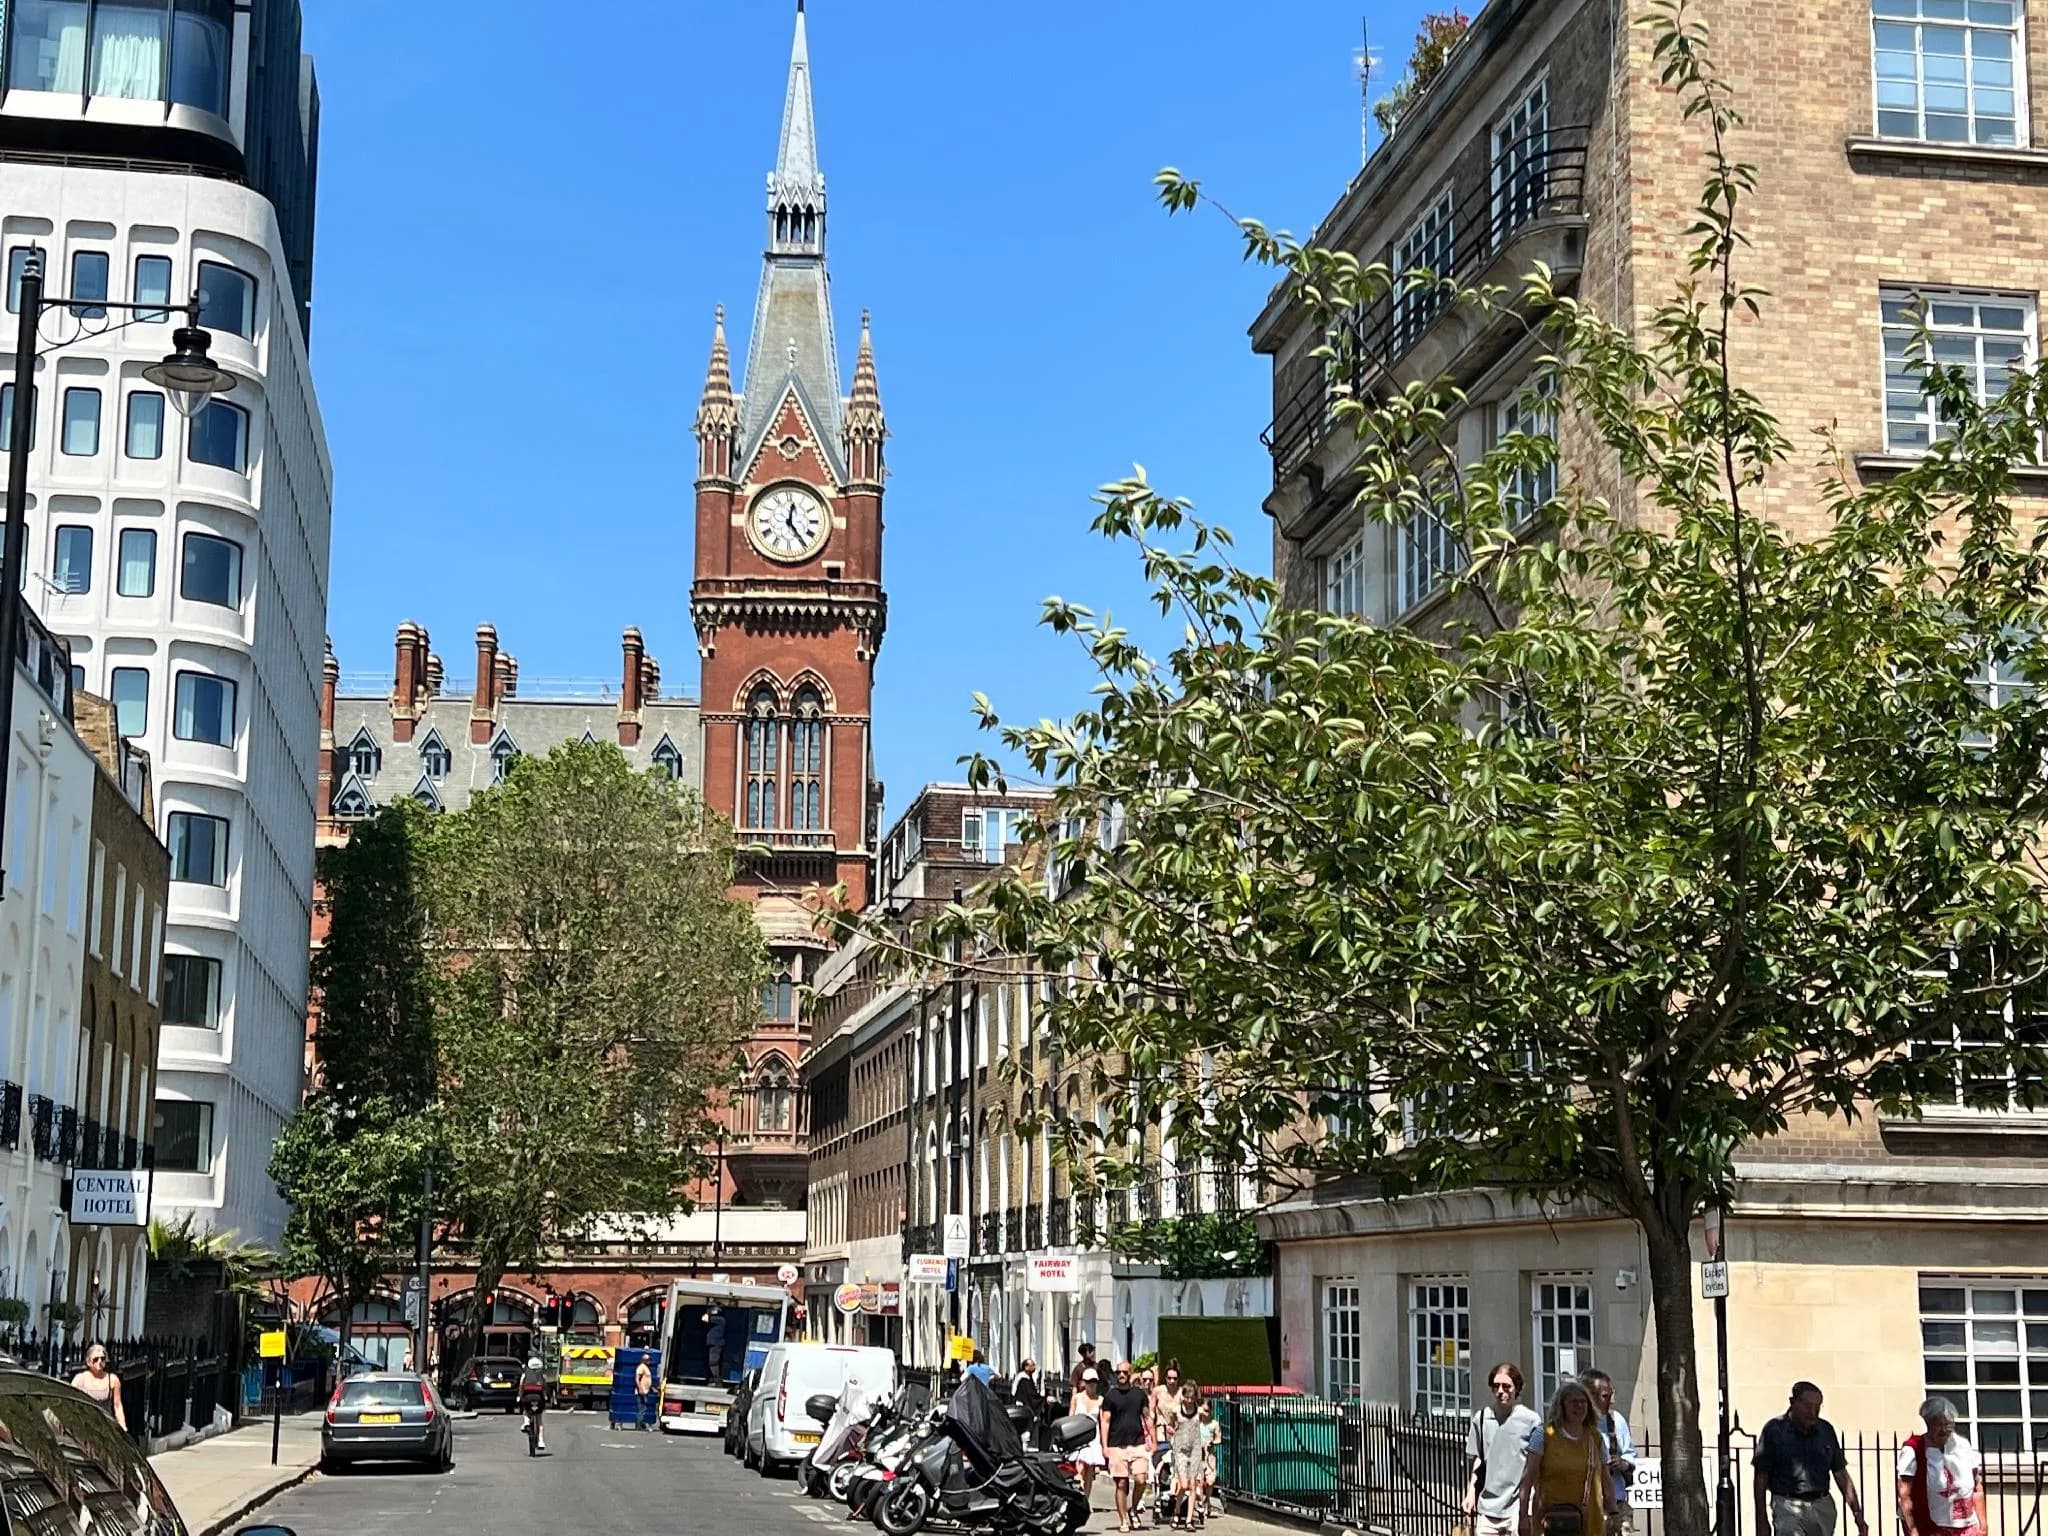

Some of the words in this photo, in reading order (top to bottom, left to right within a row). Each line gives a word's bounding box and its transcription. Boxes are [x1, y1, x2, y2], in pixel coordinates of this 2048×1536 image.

[76, 1177, 145, 1193] CENTRAL
[84, 1199, 135, 1214] HOTEL
[1034, 1260, 1071, 1268] FAIRWAY
[1040, 1270, 1066, 1278] HOTEL
[1637, 1470, 1661, 1485] CH
[1625, 1489, 1664, 1502] TREE
